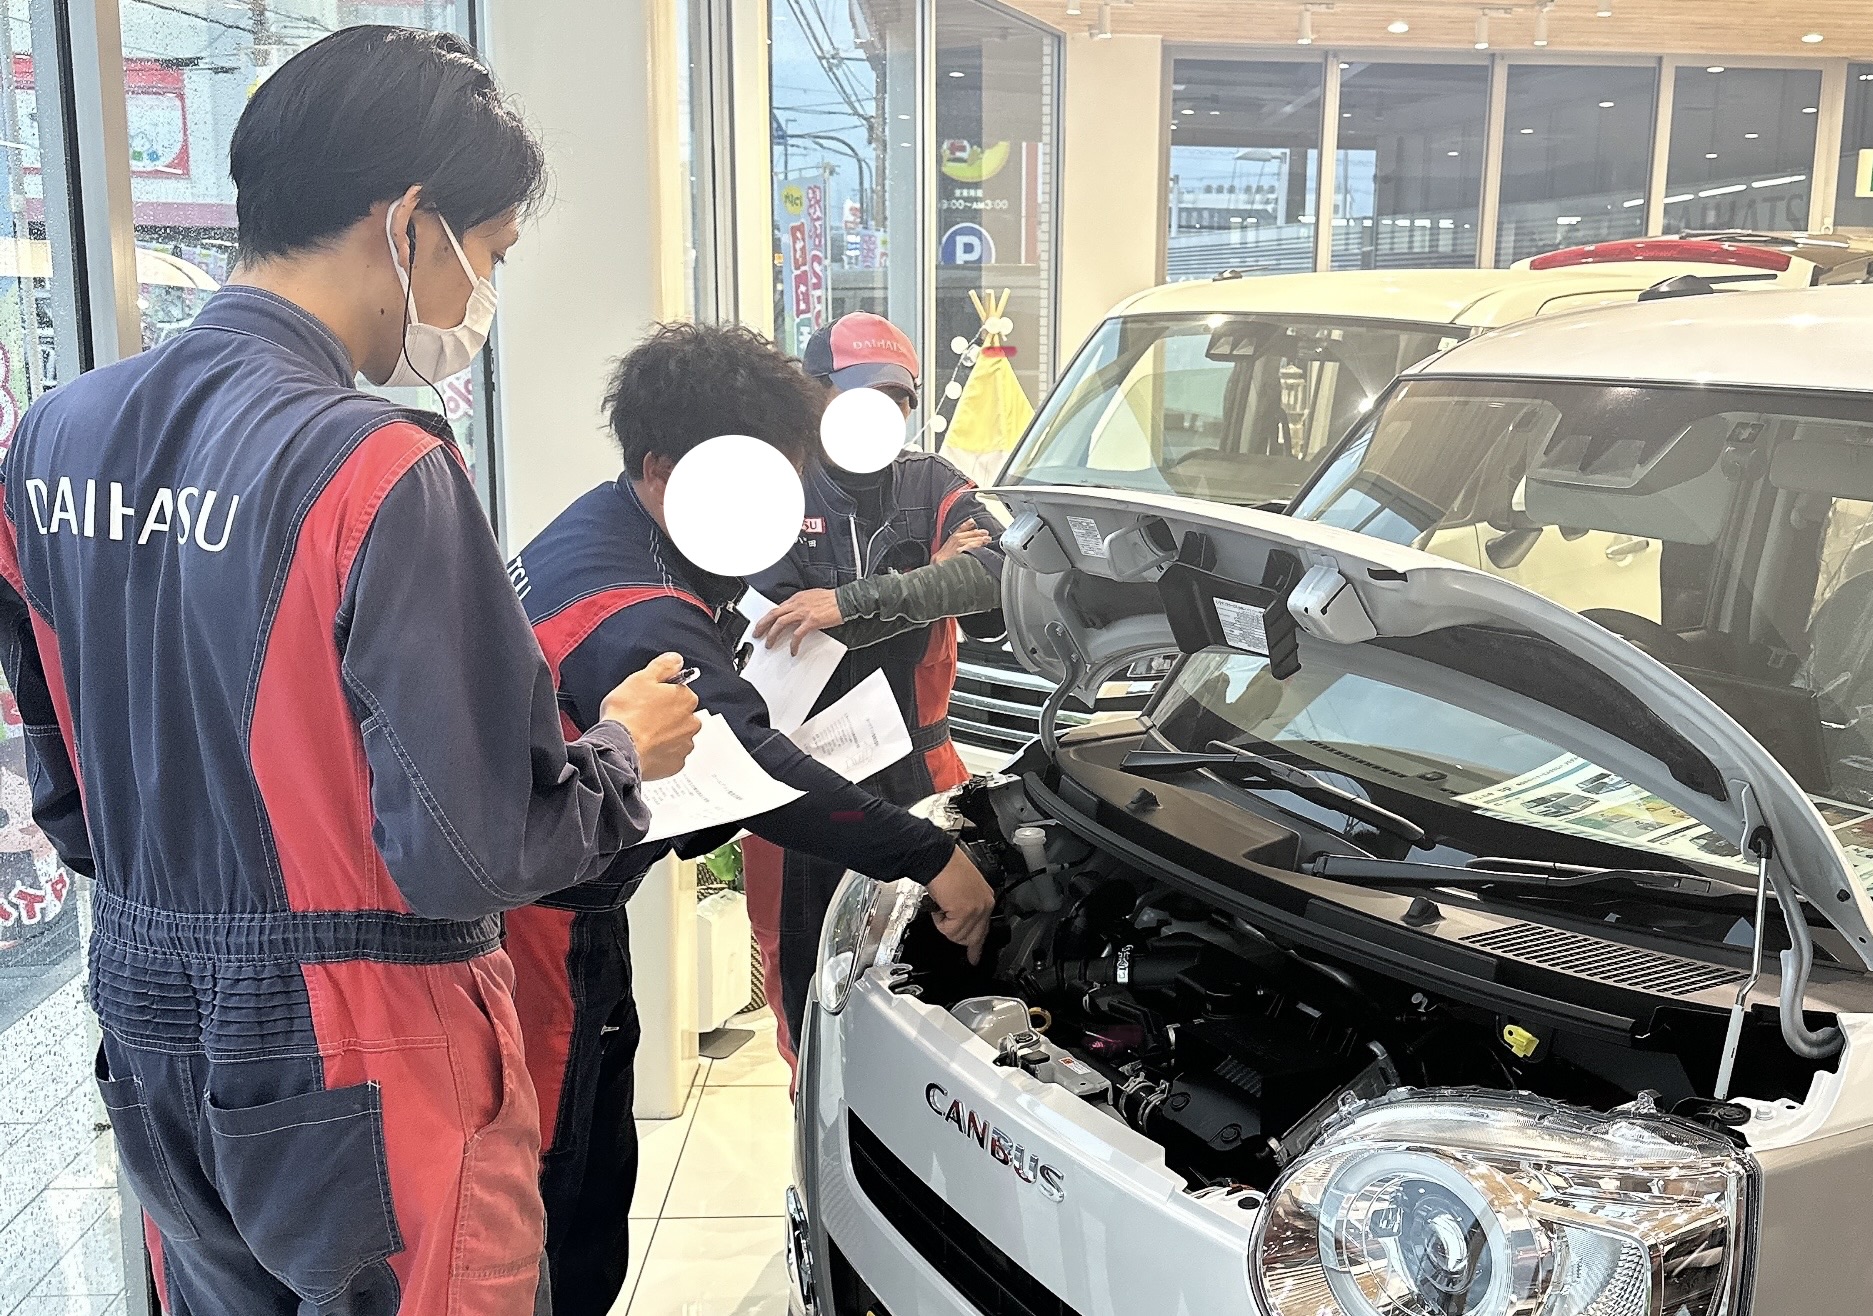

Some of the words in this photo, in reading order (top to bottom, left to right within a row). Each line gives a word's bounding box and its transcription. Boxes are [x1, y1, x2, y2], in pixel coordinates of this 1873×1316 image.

[956, 235, 981, 264] P
[26, 476, 239, 552] DAIHASU
[925, 1082, 1065, 1203] CANBUS
